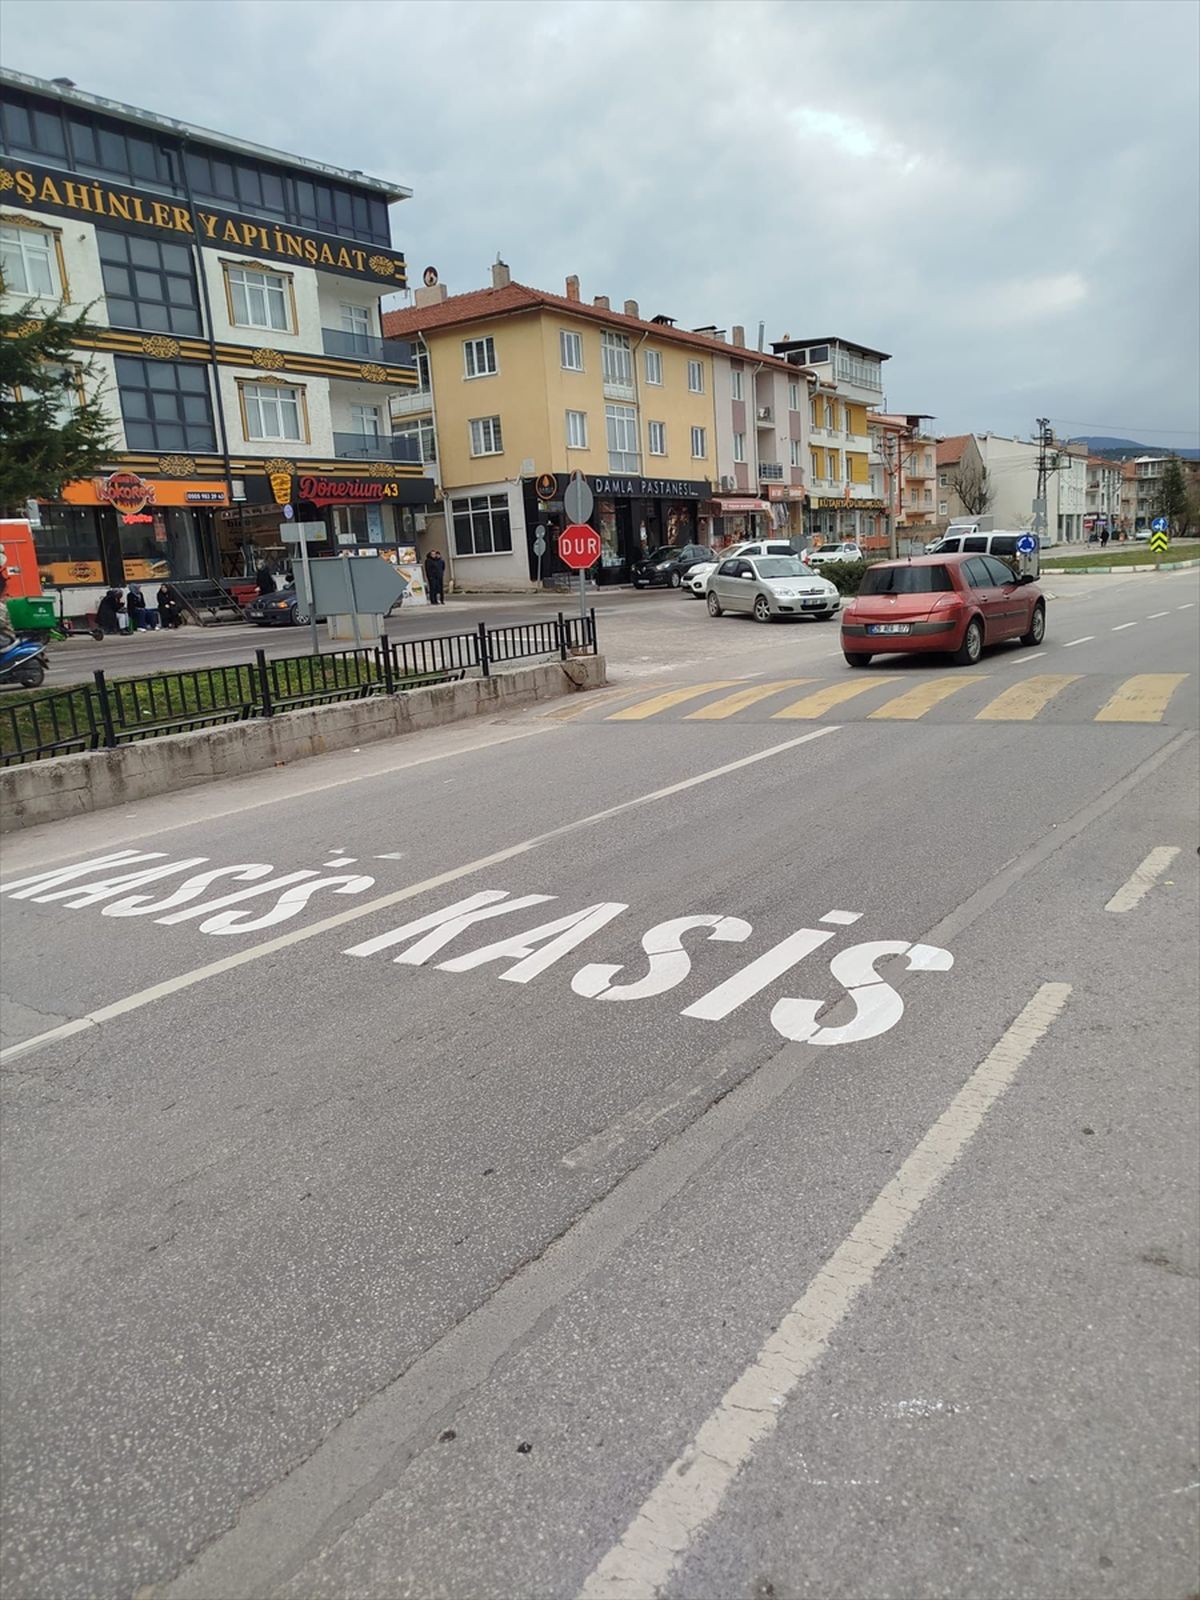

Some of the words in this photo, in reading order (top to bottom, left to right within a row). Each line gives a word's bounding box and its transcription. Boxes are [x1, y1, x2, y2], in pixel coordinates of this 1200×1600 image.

[15, 170, 195, 233] ŞAHİNLER
[198, 212, 271, 250] YAPI
[273, 225, 367, 272] İNŞAAT
[595, 478, 634, 493] DAMLA
[562, 537, 597, 556] DUR
[0, 850, 375, 936] KASİS
[341, 890, 954, 1046] KASİS
